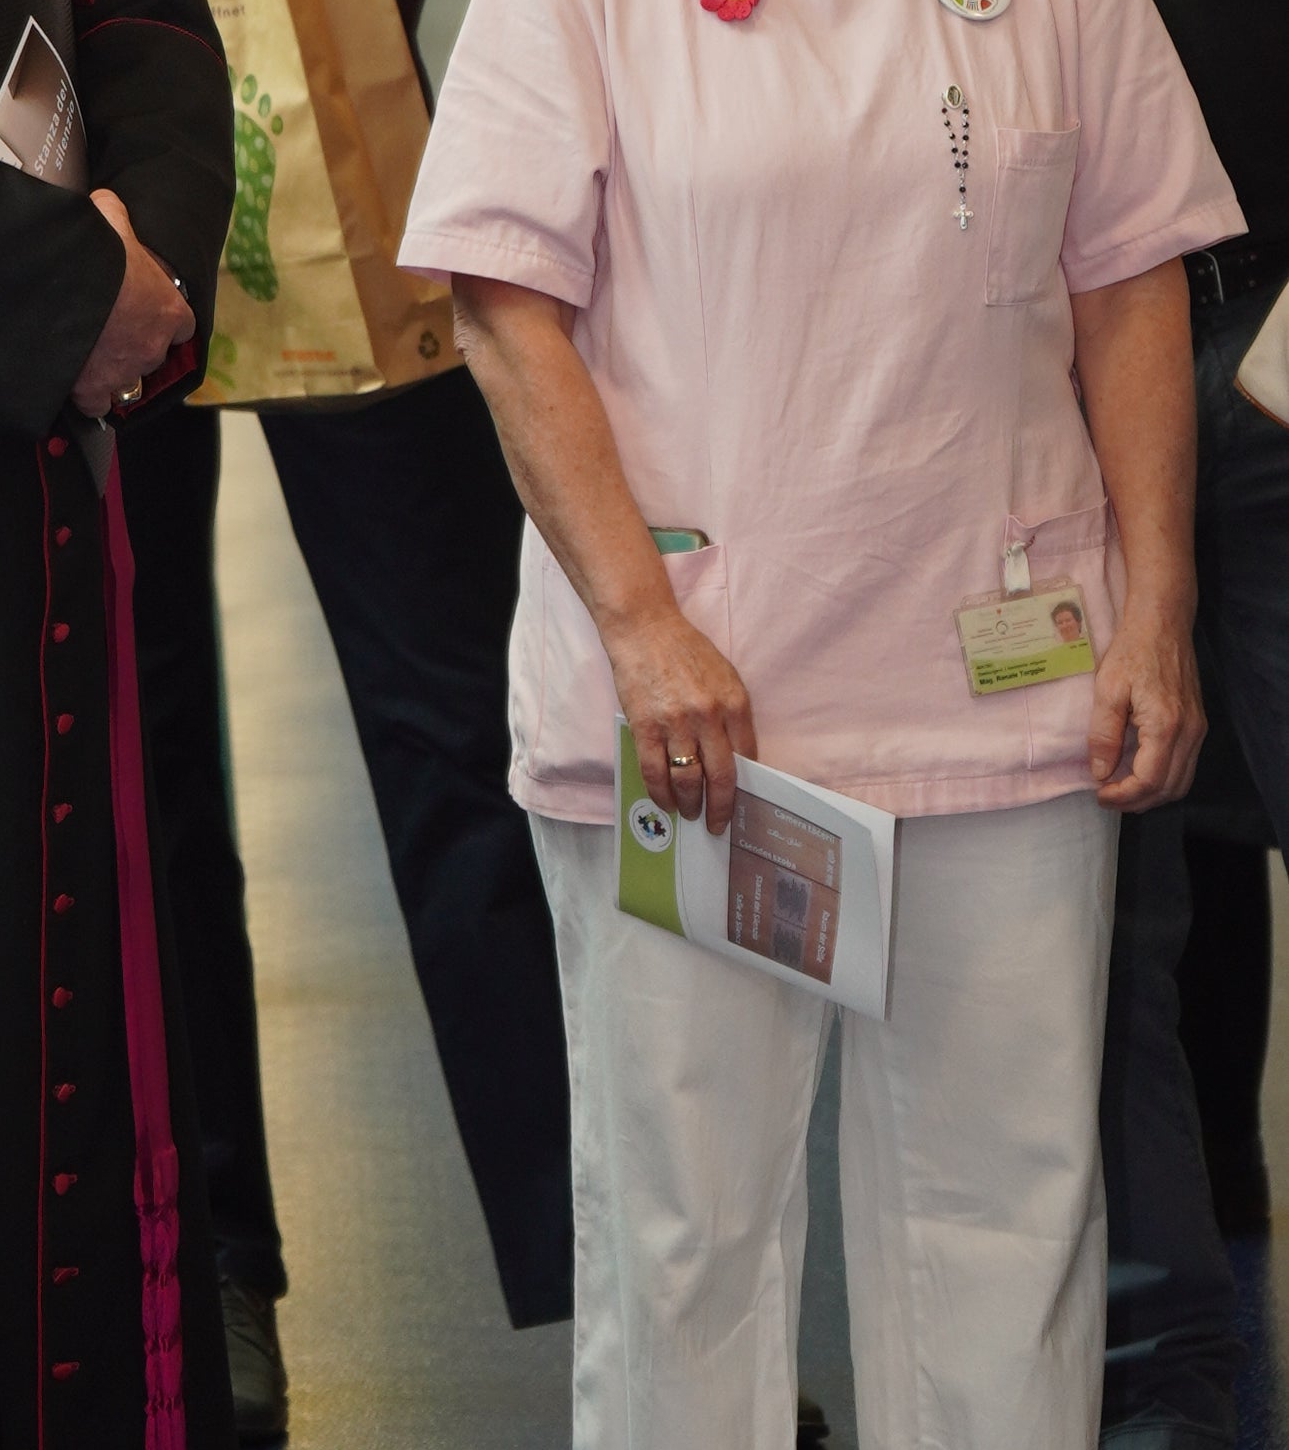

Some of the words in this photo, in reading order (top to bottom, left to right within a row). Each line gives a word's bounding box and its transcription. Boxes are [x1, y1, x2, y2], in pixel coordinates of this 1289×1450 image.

[34, 112, 60, 176] Stanza
[56, 79, 68, 113] del
[55, 100, 75, 171] silenzio
